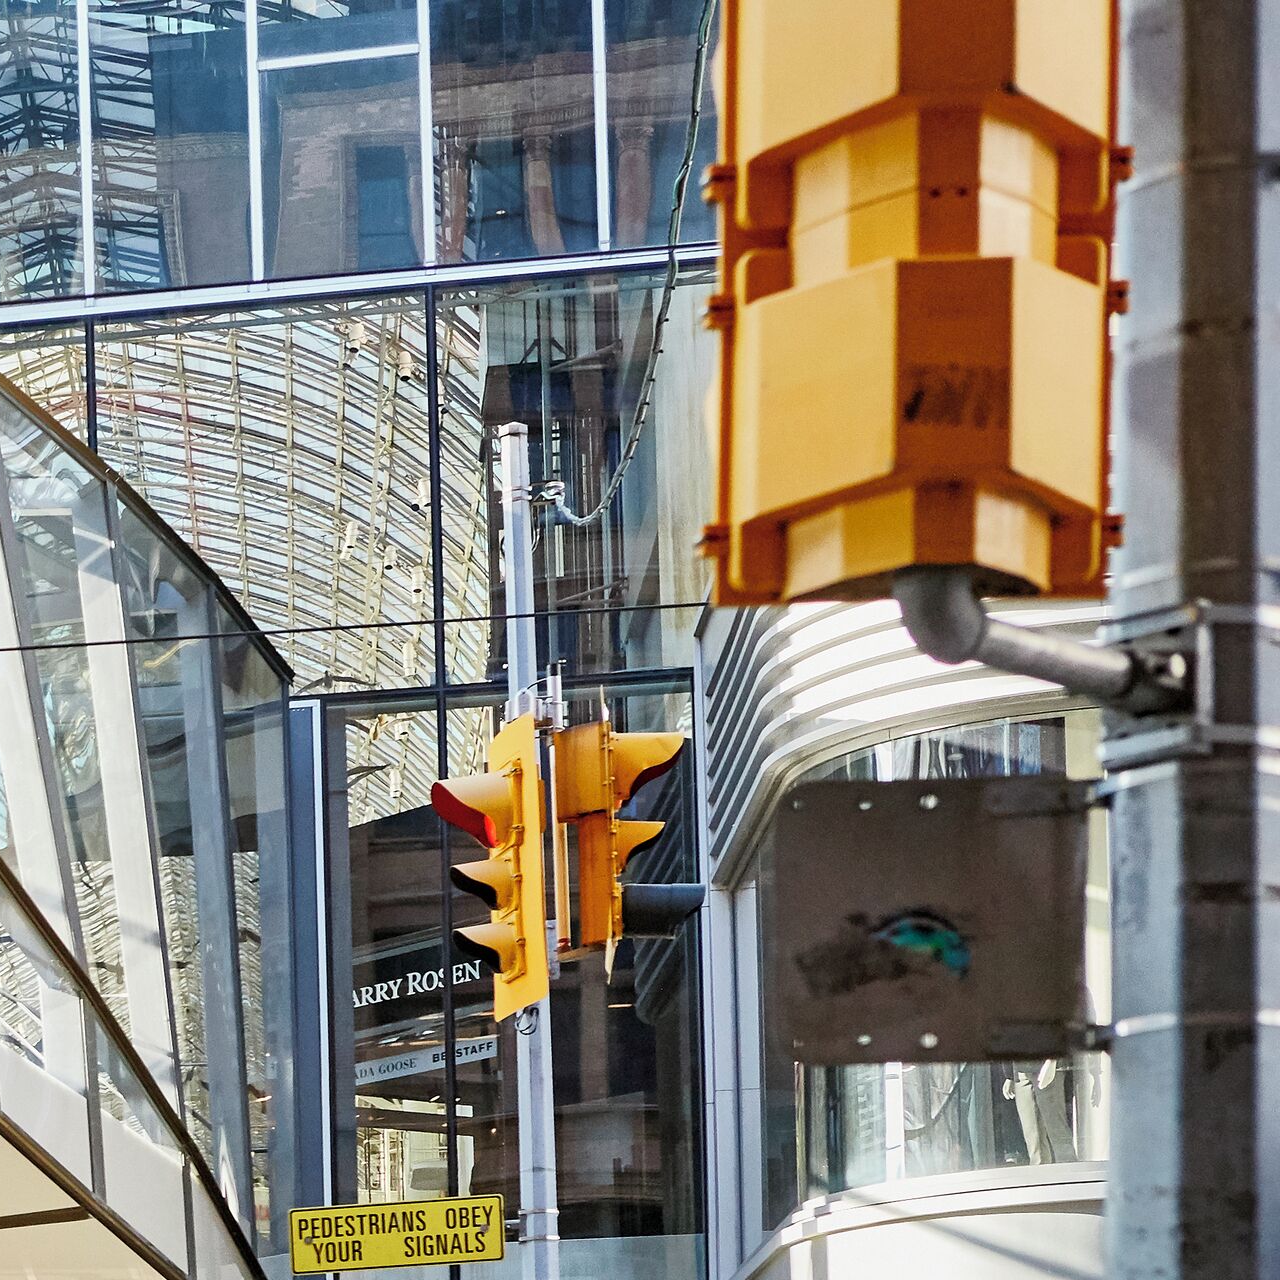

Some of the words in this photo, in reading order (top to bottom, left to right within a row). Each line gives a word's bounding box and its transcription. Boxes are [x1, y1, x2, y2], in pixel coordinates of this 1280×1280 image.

[432, 1042, 493, 1063] BESTAFF
[378, 1057, 417, 1075] GOOSE
[298, 1210, 426, 1240] PEDESTRIANS
[445, 1205, 493, 1229] OBEY
[313, 1241, 363, 1264] YOUR
[404, 1232, 486, 1257] SIGNALS
